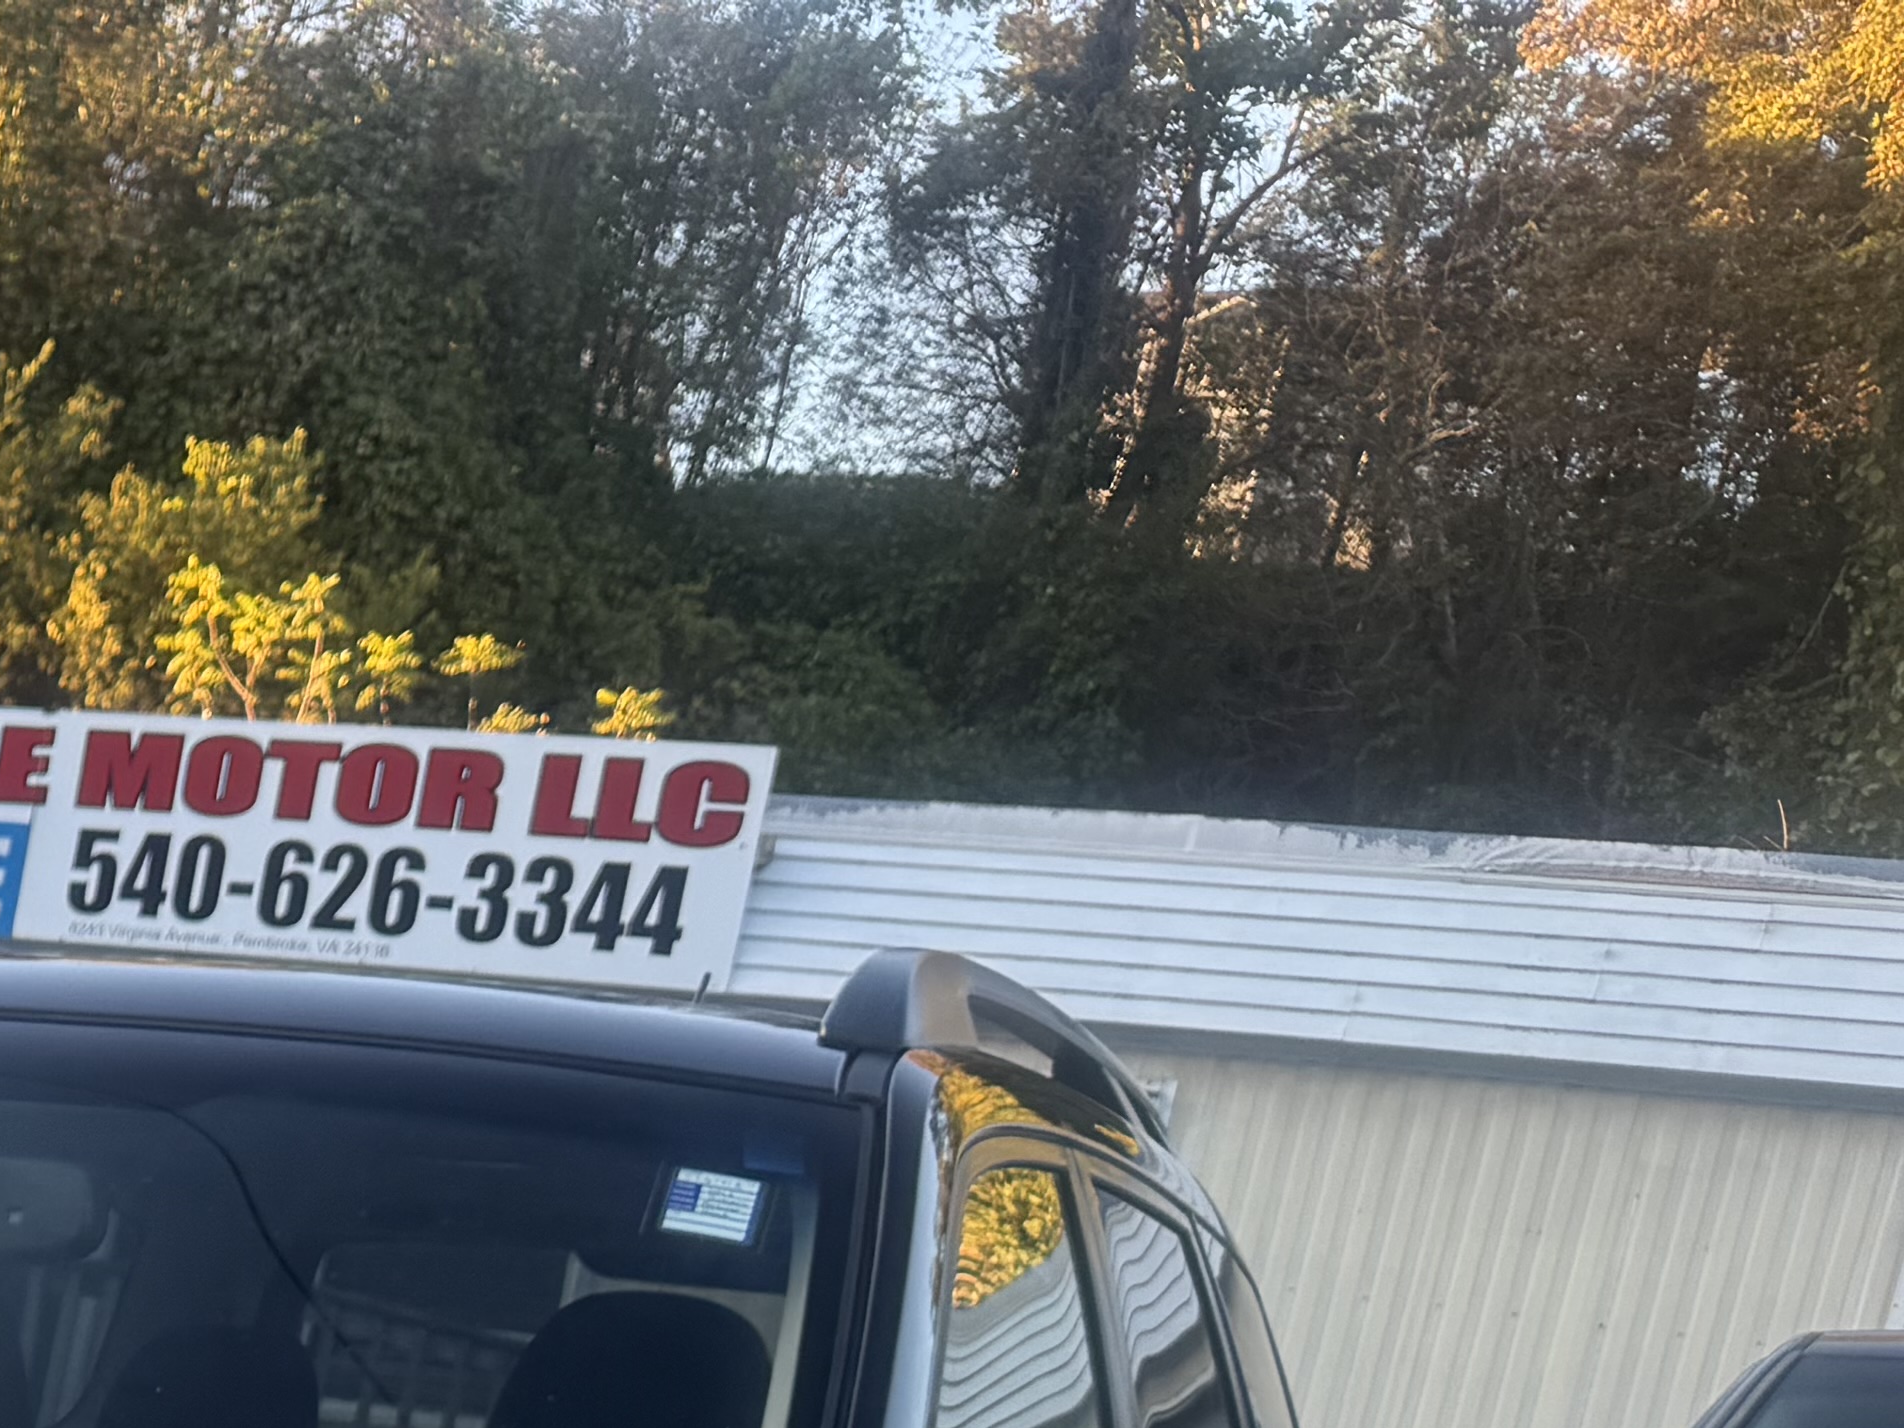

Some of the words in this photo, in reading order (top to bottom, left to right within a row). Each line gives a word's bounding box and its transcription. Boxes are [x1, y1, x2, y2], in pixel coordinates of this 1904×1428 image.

[75, 729, 505, 832] MOTOR
[528, 753, 752, 848] LLC
[66, 828, 691, 957] 540-626-3344
